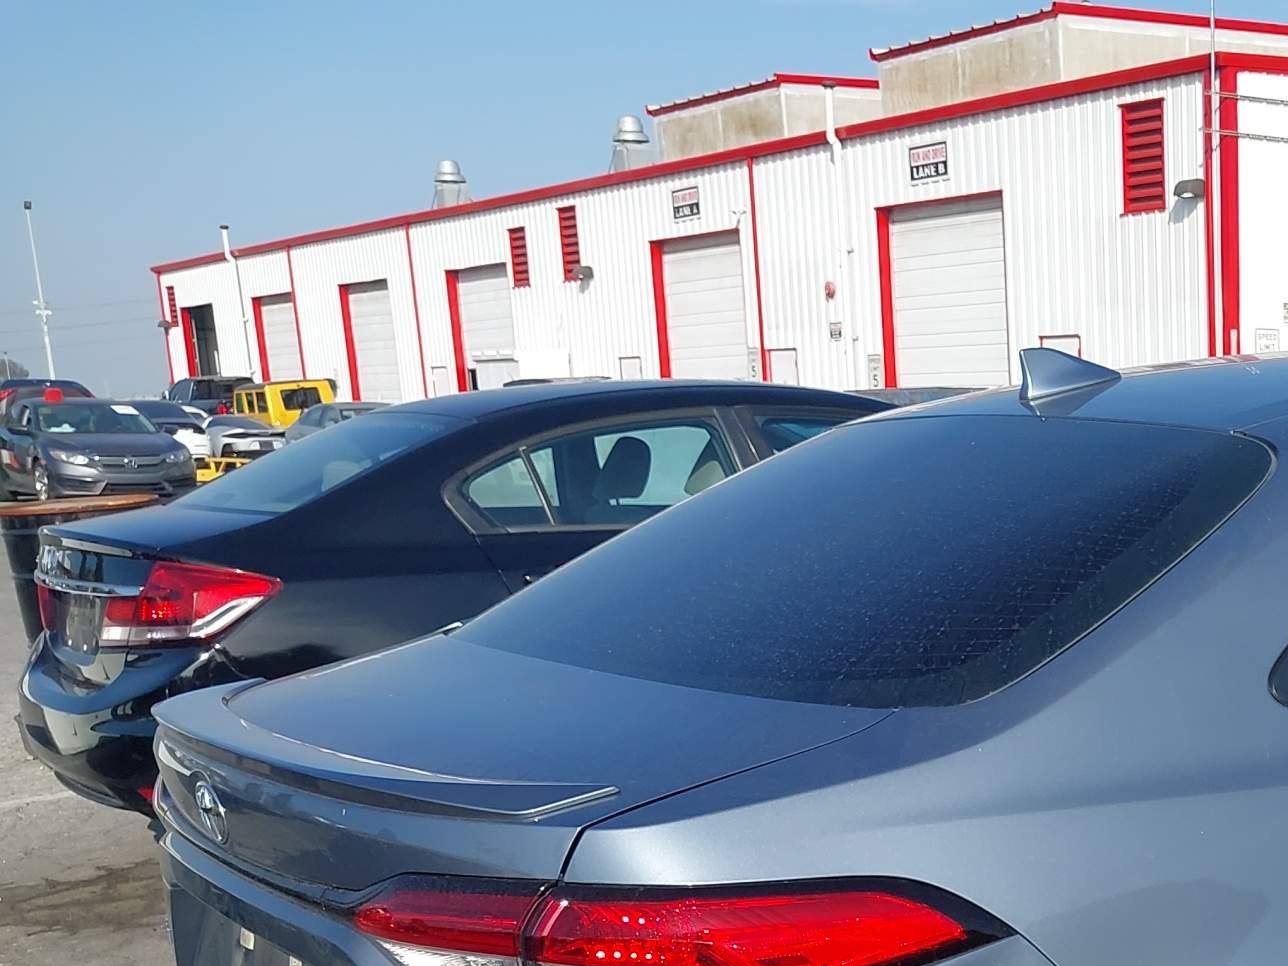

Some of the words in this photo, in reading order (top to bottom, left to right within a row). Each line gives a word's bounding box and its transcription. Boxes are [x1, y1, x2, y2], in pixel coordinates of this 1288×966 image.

[912, 164, 938, 179] LANE
[938, 162, 946, 174] B
[751, 365, 758, 378] 5
[873, 373, 880, 387] 5
